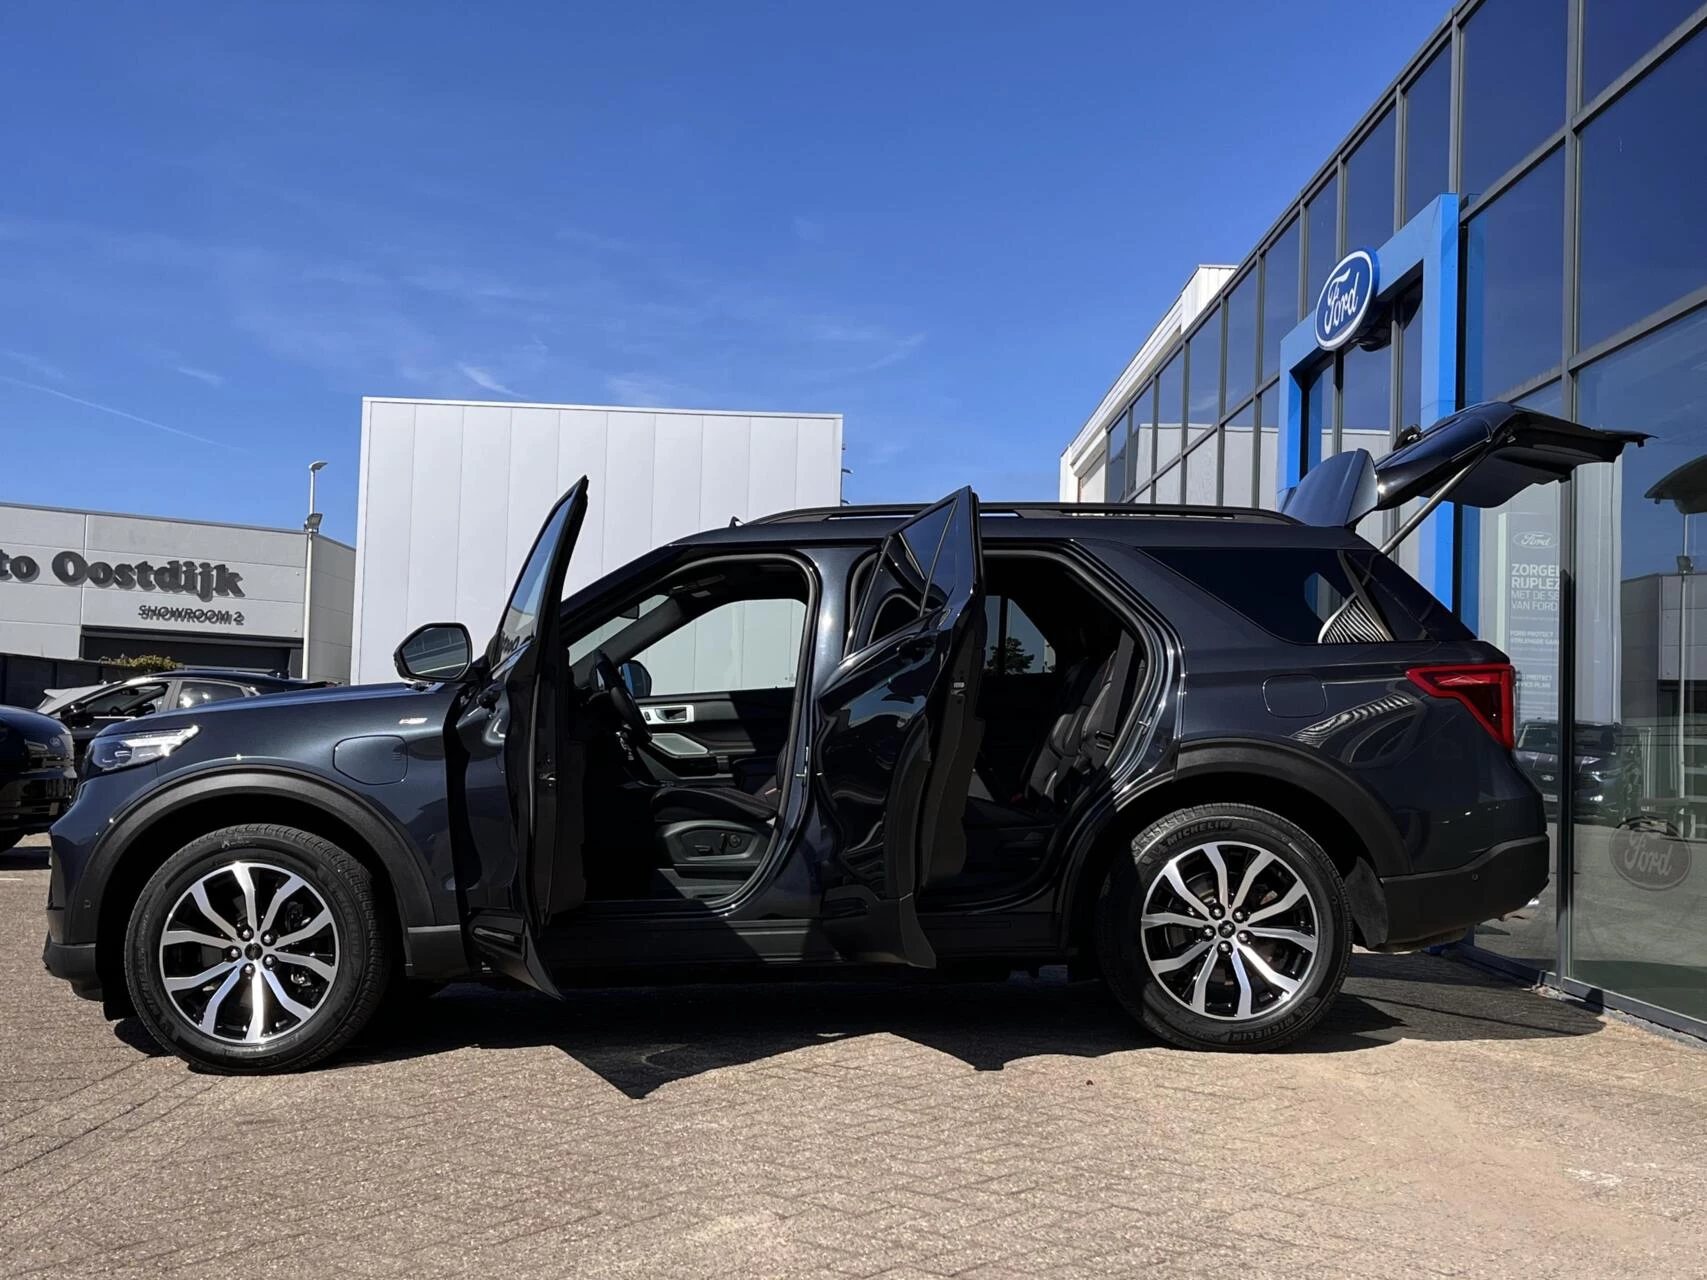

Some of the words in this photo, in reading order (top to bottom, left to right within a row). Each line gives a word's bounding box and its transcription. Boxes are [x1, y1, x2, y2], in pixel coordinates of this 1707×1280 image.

[1324, 268, 1359, 335] Ford
[1521, 534, 1552, 546] Ford
[51, 551, 245, 602] Oostdijk
[1511, 590, 1530, 600] MET
[1533, 590, 1545, 600] DE
[1511, 600, 1530, 611] VAN
[1532, 601, 1558, 612] FORD
[138, 604, 232, 624] SHOWROOM
[233, 611, 245, 626] 2
[1166, 820, 1233, 846] MICHELIN
[1625, 830, 1673, 876] Ford
